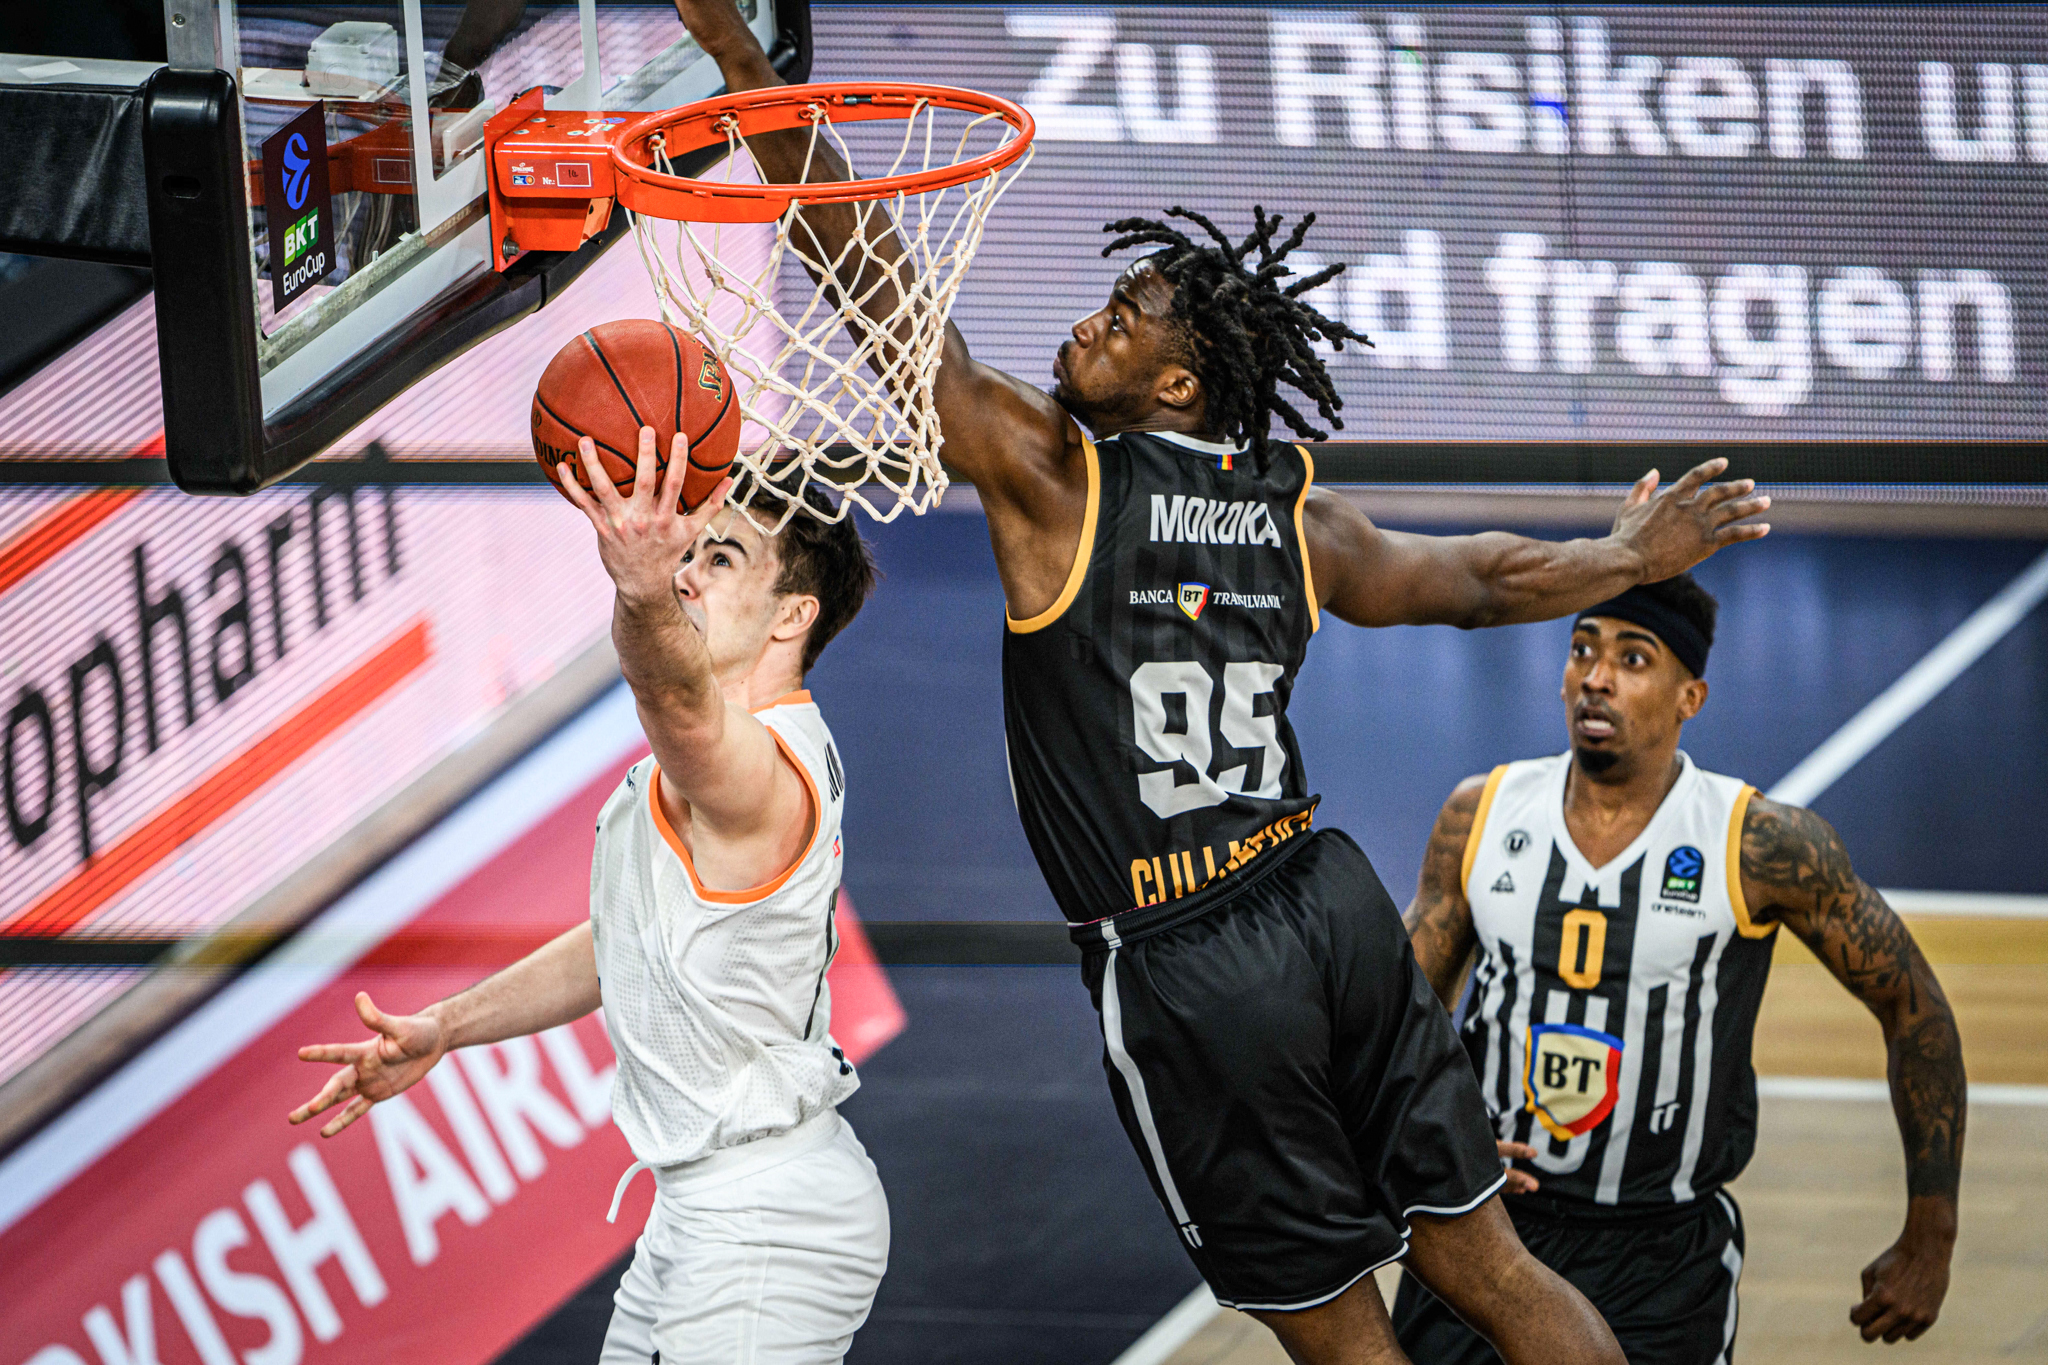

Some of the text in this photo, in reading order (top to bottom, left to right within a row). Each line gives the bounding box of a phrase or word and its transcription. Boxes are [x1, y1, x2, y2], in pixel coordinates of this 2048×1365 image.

[1003, 14, 1218, 144] Zu
[1269, 14, 1869, 160] Risiken
[284, 214, 318, 259] BKT
[283, 252, 325, 296] EuroCup
[1484, 231, 2017, 416] fragen
[1150, 494, 1281, 548] MOKOKA
[1129, 589, 1174, 604] BANCA
[1183, 590, 1202, 602] BT
[1130, 661, 1286, 819] 95
[1558, 908, 1607, 989] 0
[1542, 1051, 1600, 1093] BT
[367, 1003, 617, 1267] AIRL
